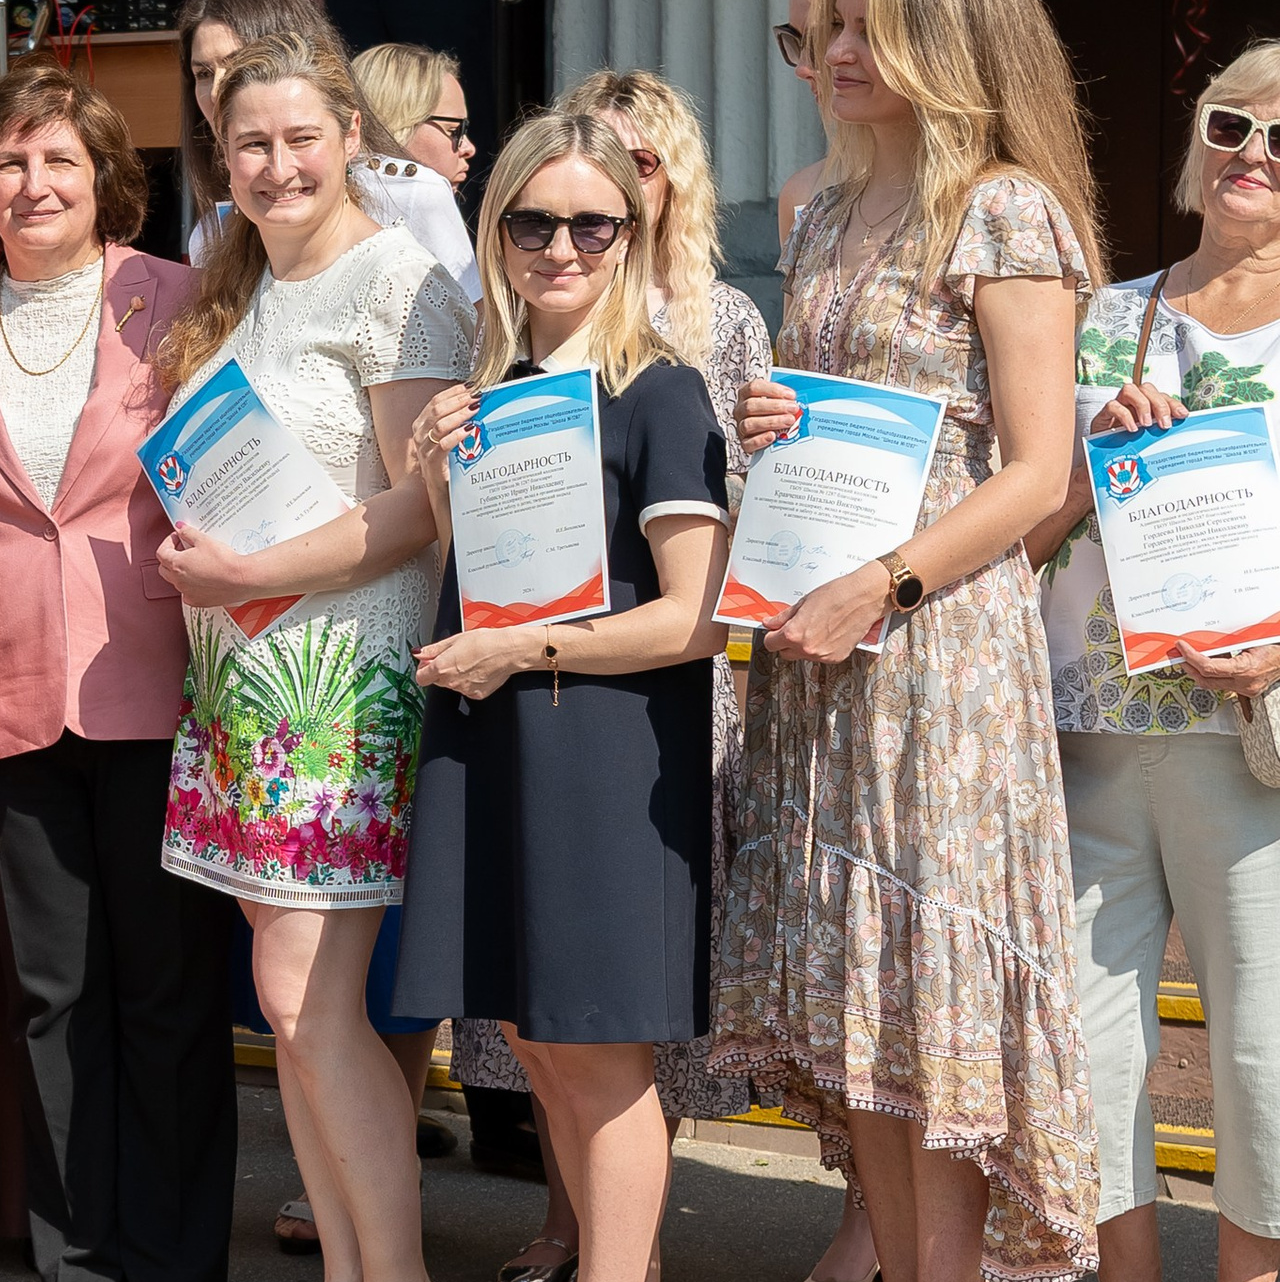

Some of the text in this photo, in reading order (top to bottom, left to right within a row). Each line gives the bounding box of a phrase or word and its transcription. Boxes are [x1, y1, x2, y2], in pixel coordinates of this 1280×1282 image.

[184, 435, 262, 509] БЛАГОДАРНОСТЬ
[470, 451, 572, 485] БЛАГОДАРНОСТЬ
[774, 462, 892, 494] БЛАГОДАРНОСТЬ
[806, 494, 836, 506] Наталью
[1128, 487, 1254, 523] БЛАГОДАРНОСТЬ
[1175, 521, 1206, 533] Николая
[1175, 529, 1207, 542] Наталью
